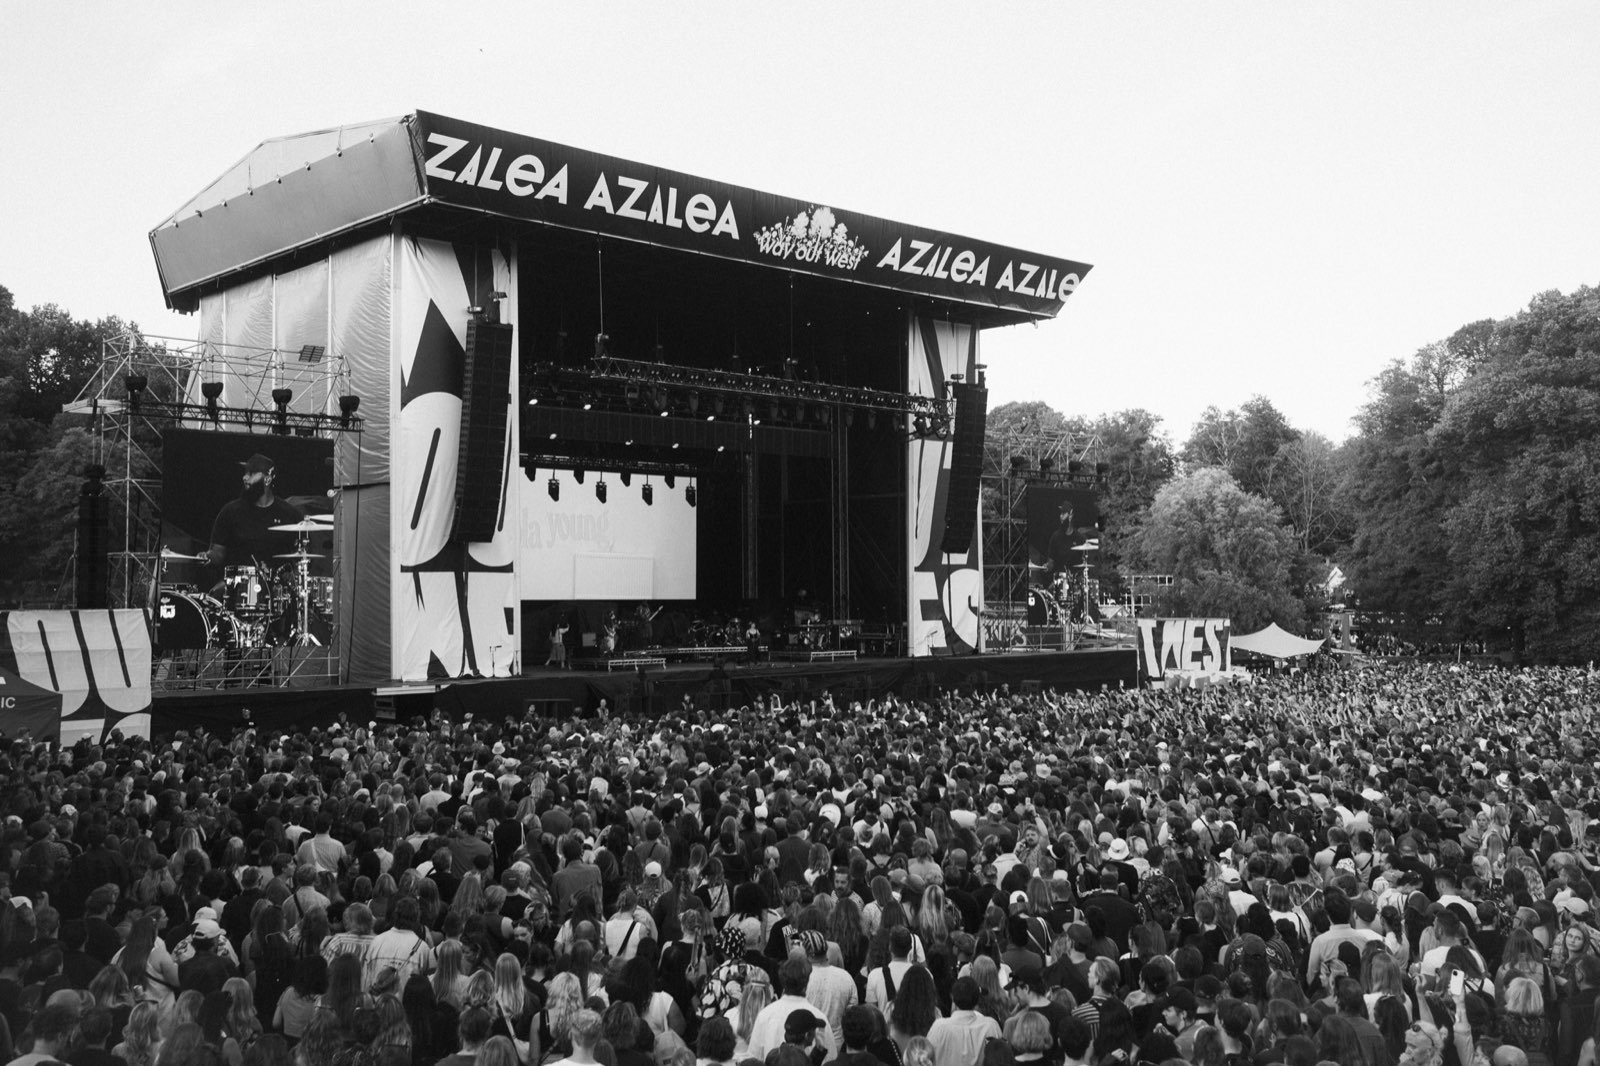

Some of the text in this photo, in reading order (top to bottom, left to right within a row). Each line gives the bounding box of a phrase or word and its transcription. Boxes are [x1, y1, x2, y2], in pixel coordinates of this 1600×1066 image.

[759, 235, 863, 270] way out west
[547, 509, 610, 551] young
